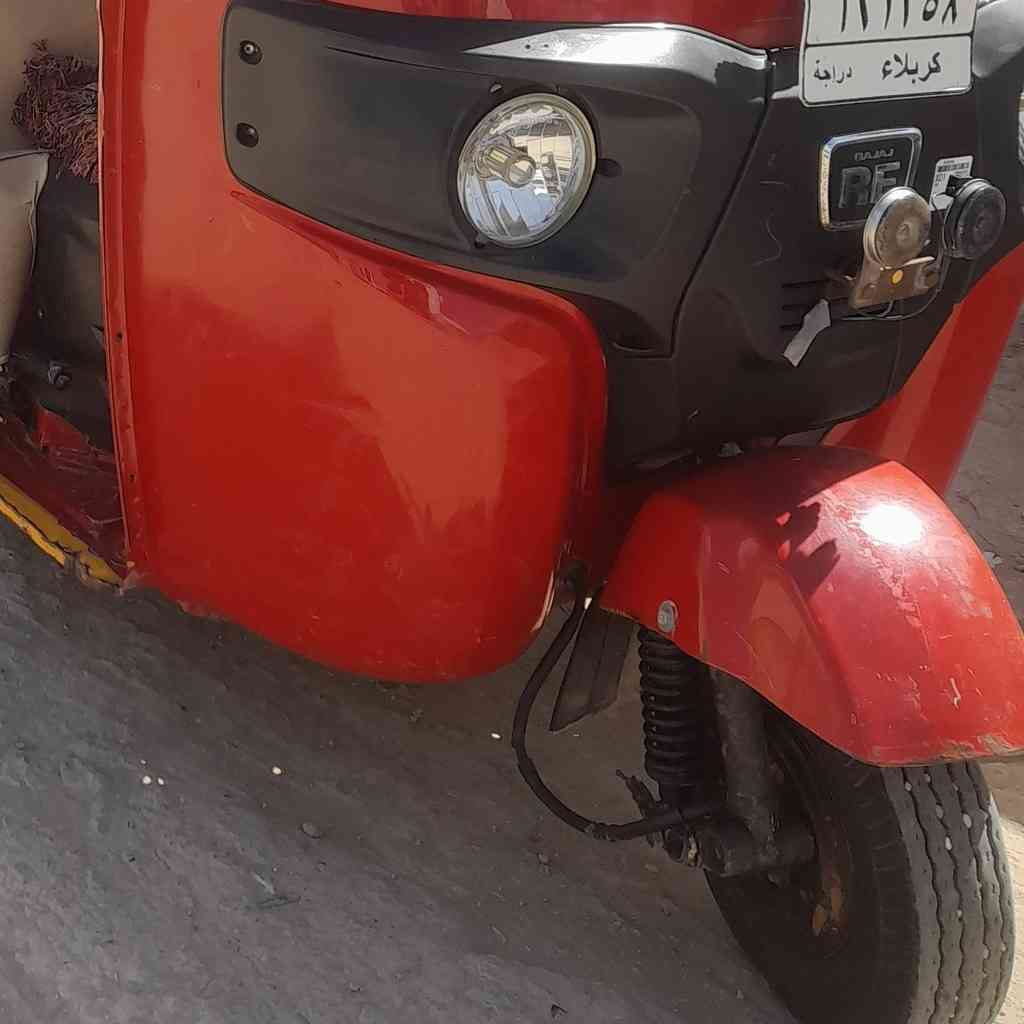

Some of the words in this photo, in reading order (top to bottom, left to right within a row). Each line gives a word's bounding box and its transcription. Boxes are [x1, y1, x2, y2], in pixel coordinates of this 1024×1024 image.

[813, 58, 853, 88] دراجة
[881, 51, 942, 84] كربلاء
[838, 161, 901, 208] RE
